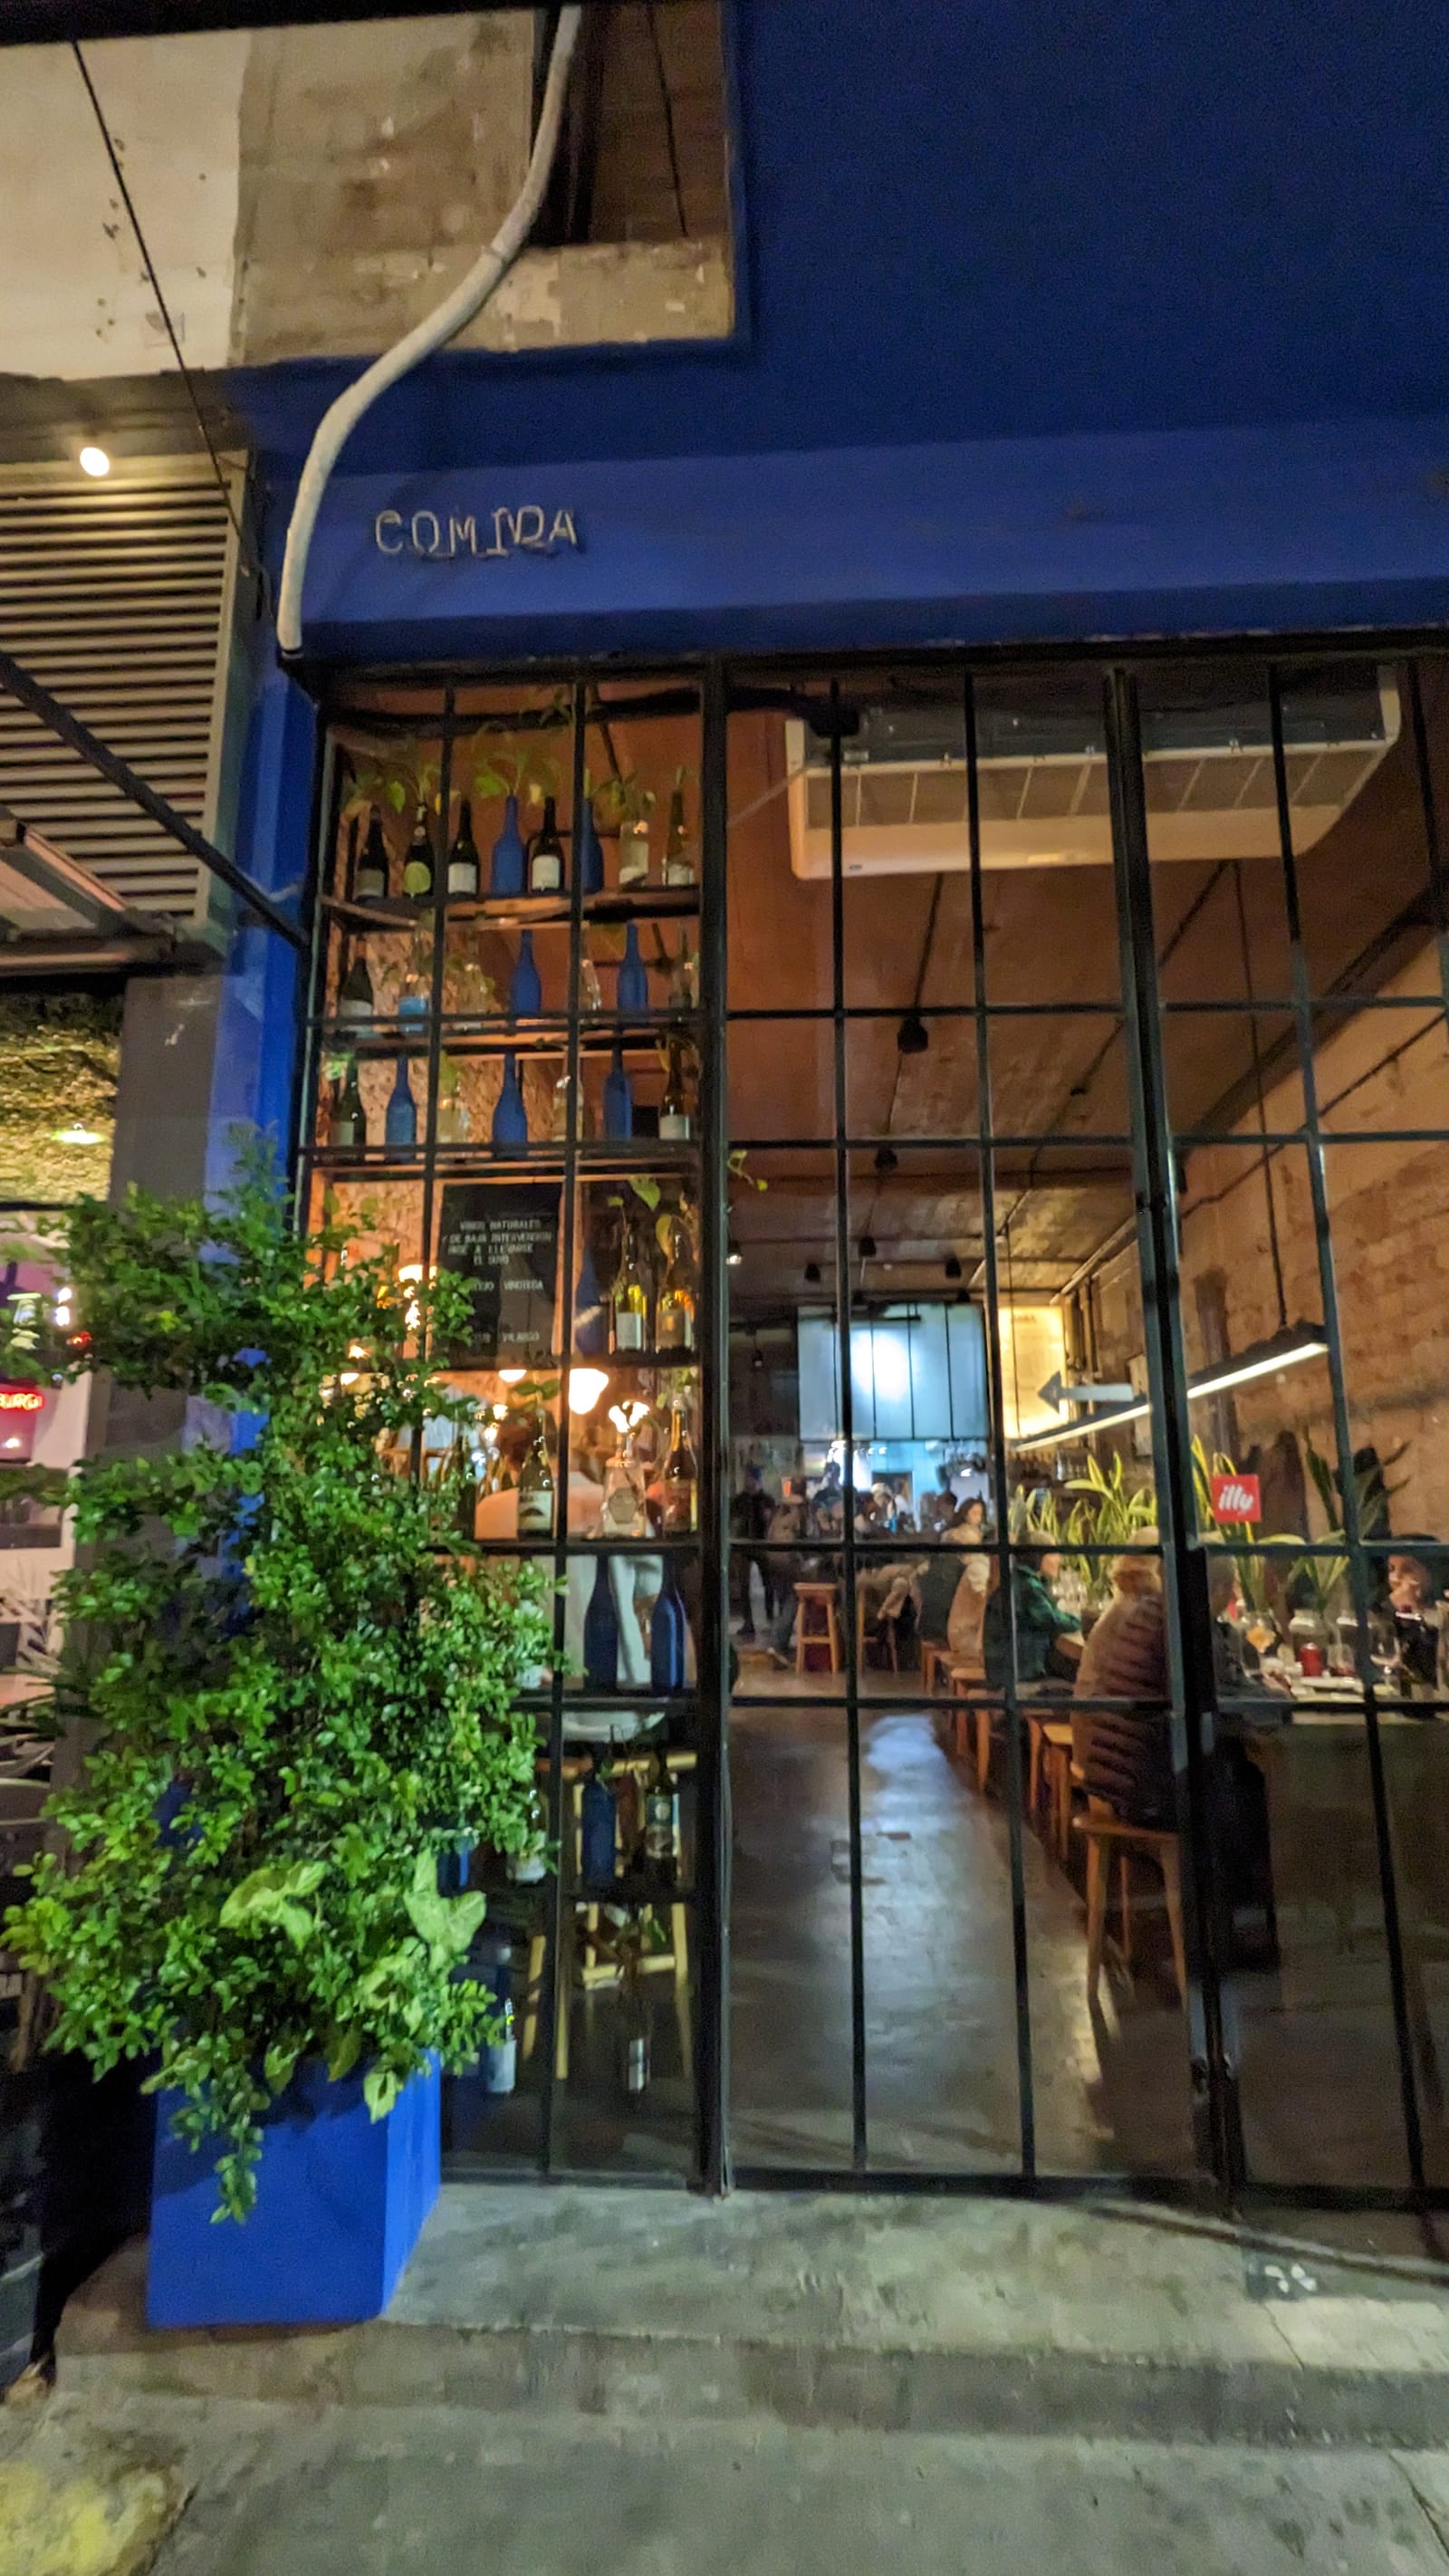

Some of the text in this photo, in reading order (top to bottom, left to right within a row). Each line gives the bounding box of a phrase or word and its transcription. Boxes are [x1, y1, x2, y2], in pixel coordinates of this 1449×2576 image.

[375, 505, 579, 556] COMIDA
[490, 1219, 542, 1230] NATURALES
[1218, 1485, 1254, 1516] illy
